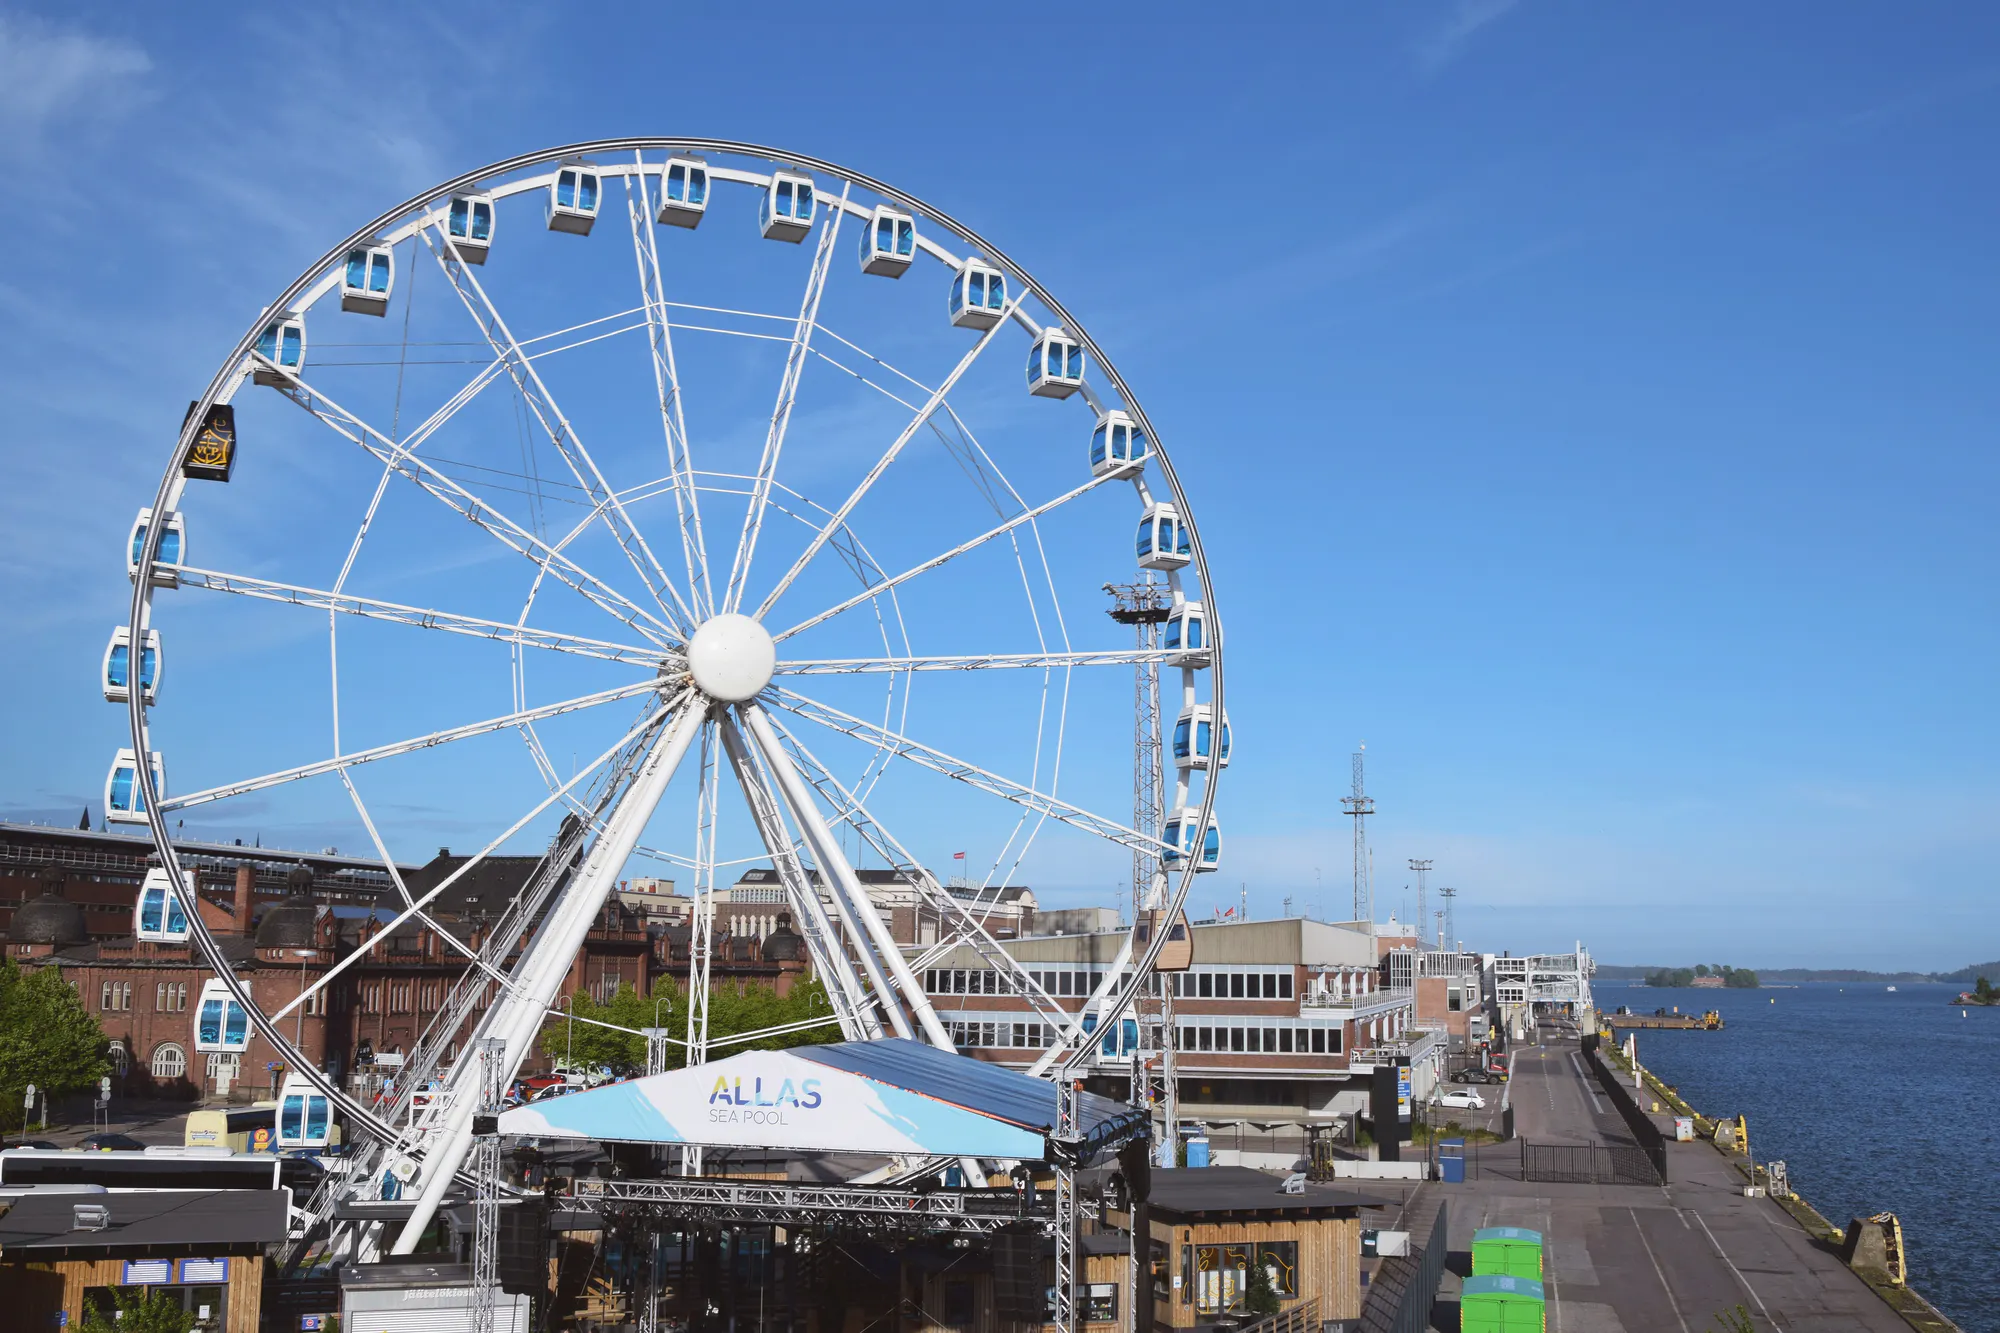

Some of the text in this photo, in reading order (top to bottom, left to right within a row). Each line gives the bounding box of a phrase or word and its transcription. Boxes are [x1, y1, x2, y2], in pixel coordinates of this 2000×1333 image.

[709, 1075, 822, 1109] ALLAS
[709, 1109, 788, 1125] SEA POOL
